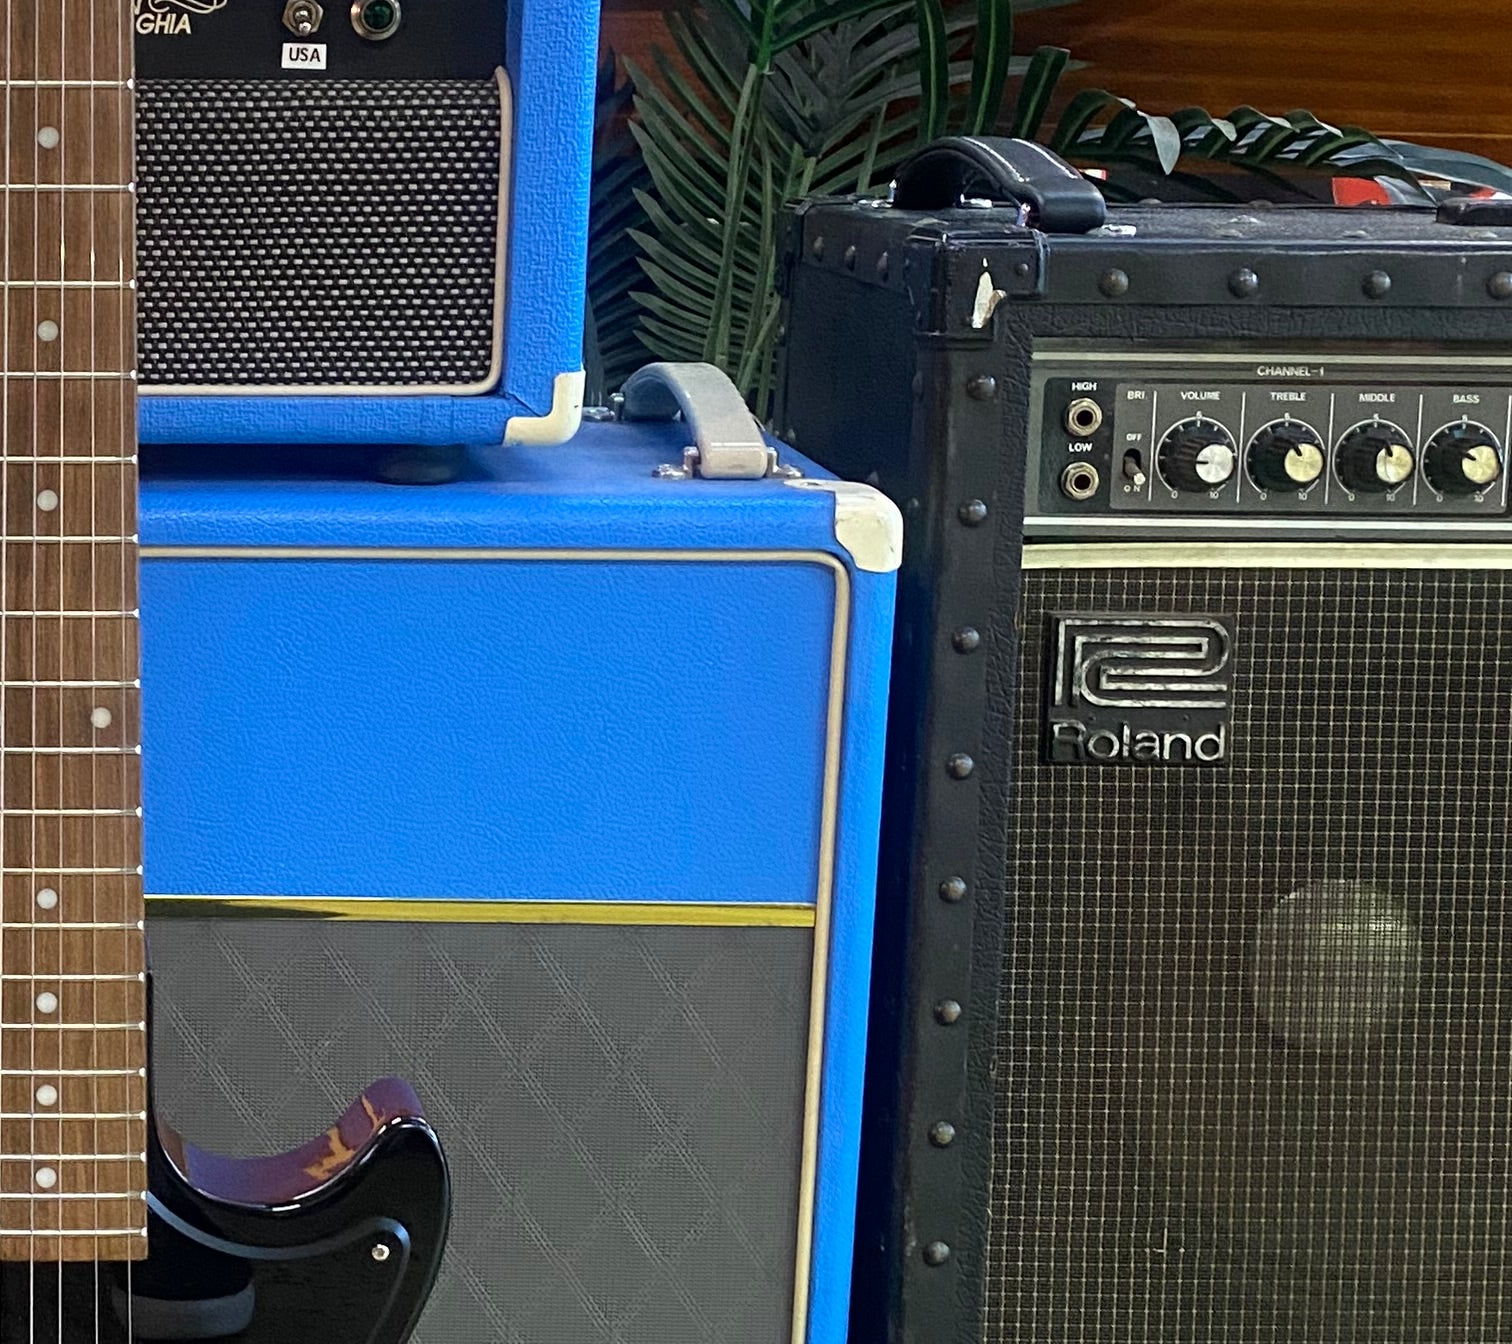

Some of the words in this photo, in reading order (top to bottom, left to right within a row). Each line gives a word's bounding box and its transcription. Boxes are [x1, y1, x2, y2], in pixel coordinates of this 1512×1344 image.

[136, 13, 192, 35] GHIA
[289, 47, 321, 63] USA
[1071, 381, 1098, 391] HIGH
[1126, 390, 1146, 400] BRI
[1180, 391, 1221, 401] VOLUME
[1270, 391, 1307, 402] TREBLE
[1358, 392, 1396, 403] MIDDLE
[1452, 394, 1480, 404] BASS
[1126, 434, 1142, 442] OFF
[1068, 442, 1093, 453] LOW
[1050, 720, 1225, 762] Roland
